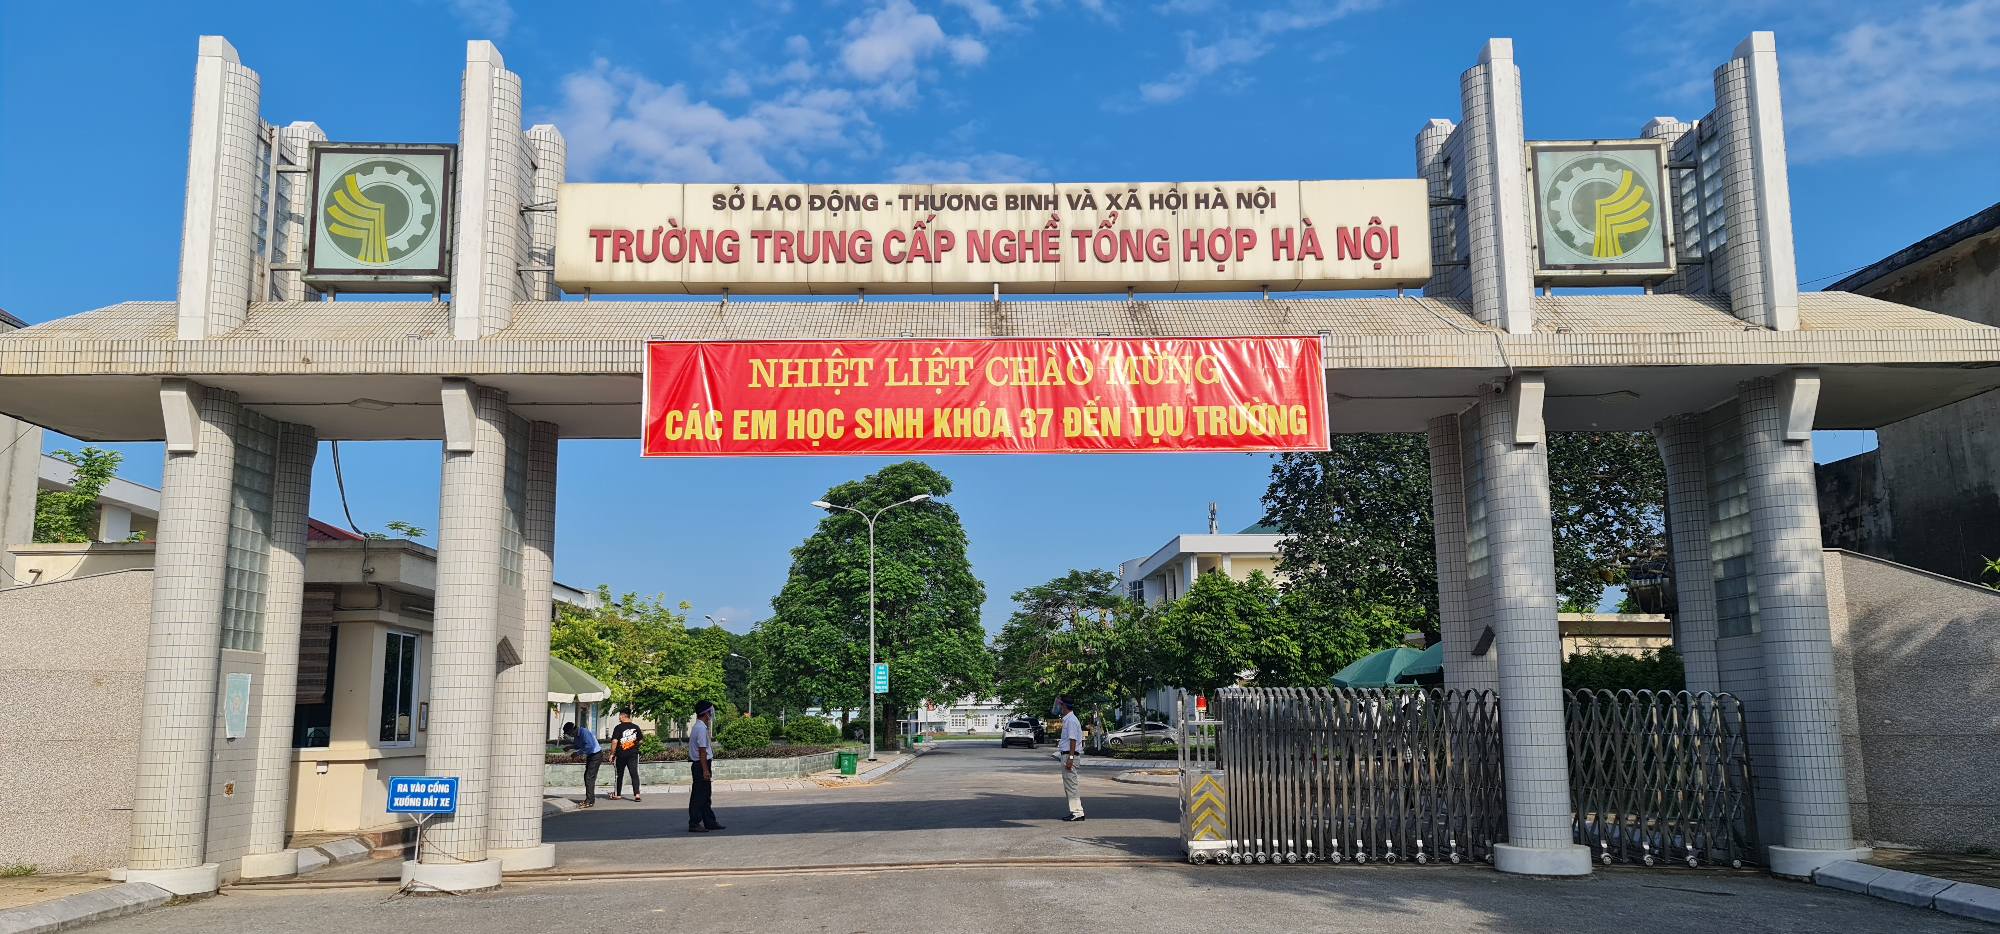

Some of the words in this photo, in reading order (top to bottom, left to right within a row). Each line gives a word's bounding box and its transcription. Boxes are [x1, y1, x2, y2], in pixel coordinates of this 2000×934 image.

[712, 186, 746, 211] SỞ
[752, 194, 802, 211] LAO
[808, 190, 879, 217] ĐỘNG
[898, 194, 998, 211] THƯƠNG
[1005, 193, 1059, 211] BINH
[1066, 189, 1098, 211] VÀ
[1105, 189, 1142, 211] XÃ
[1149, 187, 1188, 215] HỘI
[1195, 188, 1229, 210] HÀ
[1236, 187, 1277, 214] NỘI
[589, 219, 740, 264] TRƯỜNG
[750, 230, 874, 264] TRUNG
[883, 214, 956, 264] CẤP
[966, 214, 1061, 263] NGHỀ
[1071, 211, 1170, 263] TỔNG
[1183, 227, 1257, 272] HỢP
[1271, 218, 1324, 262] HÀ
[1337, 216, 1400, 270] NỘI
[748, 348, 873, 395] NHIỆT
[885, 347, 974, 394] LIỆT
[985, 348, 1094, 386] CHÀO
[1106, 349, 1220, 385] MỪNG
[665, 403, 723, 441] CÁC
[733, 410, 777, 440] EM
[787, 408, 845, 447] HỌC
[855, 408, 924, 439] SINH
[934, 401, 1011, 438] KHÓA
[1021, 408, 1053, 438] 37
[1062, 396, 1121, 437] ĐẾN
[1130, 402, 1184, 443] TỰU
[1193, 397, 1308, 436] TRƯỜNG
[393, 795, 421, 807] XUỐNG
[440, 797, 451, 807] XE
[397, 783, 408, 793] RA
[410, 782, 426, 793] VÀO
